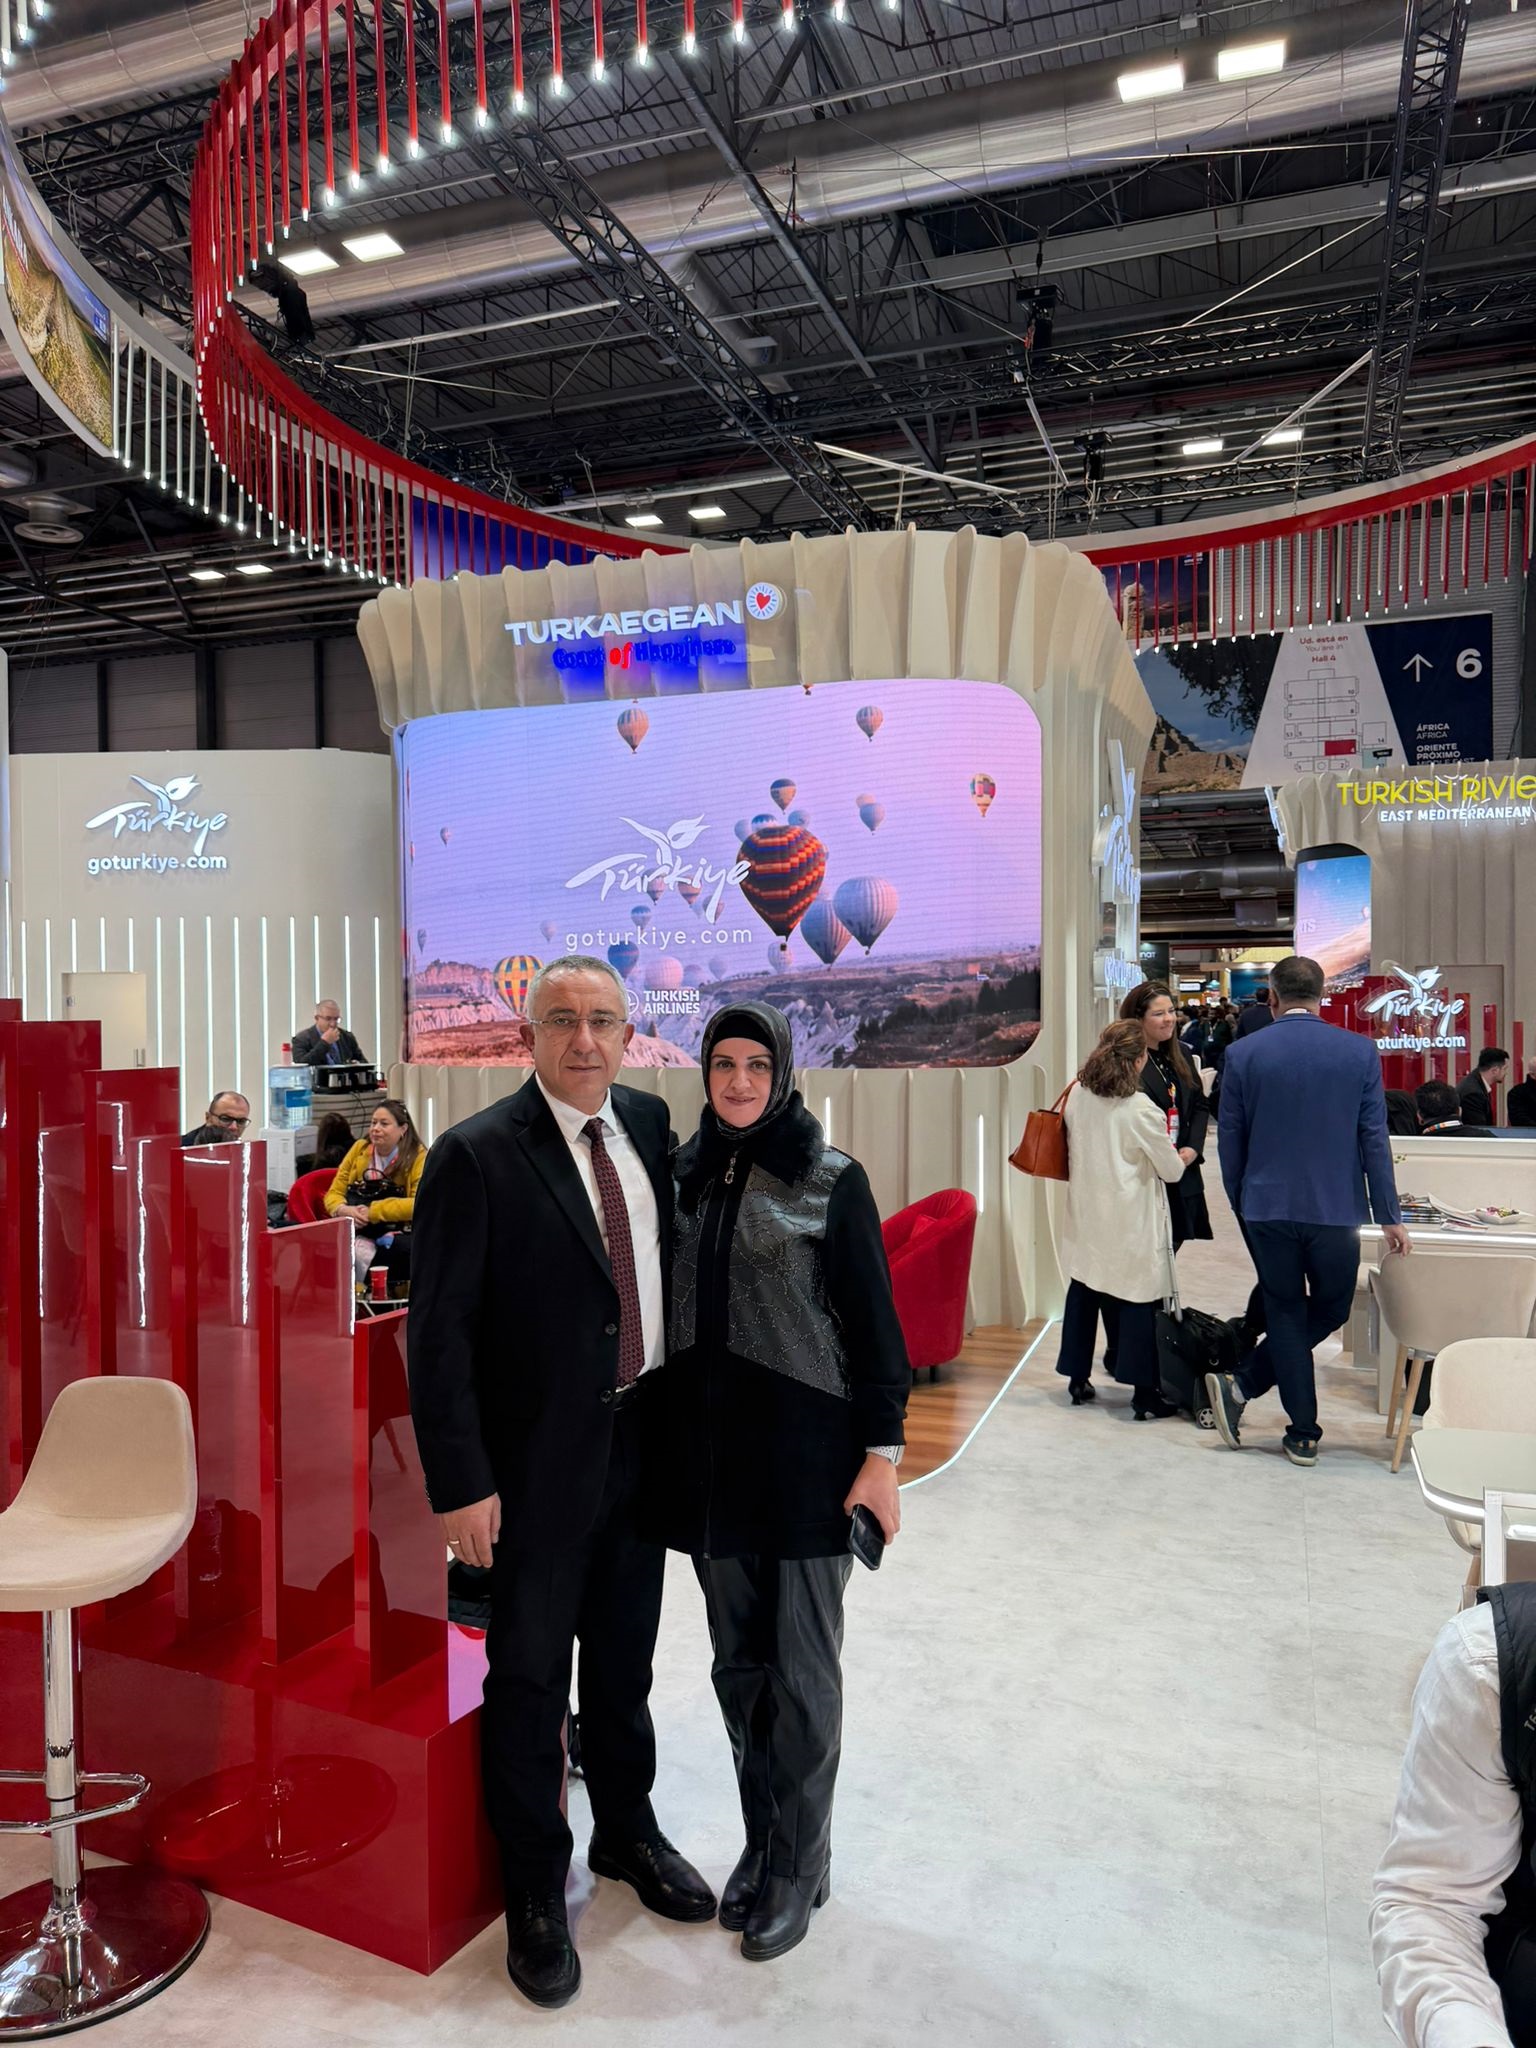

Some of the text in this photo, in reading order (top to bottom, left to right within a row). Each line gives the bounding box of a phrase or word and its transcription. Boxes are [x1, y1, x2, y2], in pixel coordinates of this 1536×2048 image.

[504, 599, 744, 645] TURKAEGEAN
[609, 641, 632, 669] of
[1456, 648, 1483, 679] 6
[1416, 722, 1451, 732] ÁFRICA
[1416, 743, 1458, 752] ORIENTE
[1337, 780, 1453, 807] TURKISH
[85, 796, 228, 857] Türkiye
[1380, 805, 1531, 823] EAST MEDITERRANEAN
[87, 853, 228, 875] goturkiye.com
[564, 851, 752, 924] Türkiye
[565, 925, 752, 952] goturkiye.com
[643, 990, 700, 1003] TURKISH
[643, 1002, 700, 1015] AIRLINES
[1366, 988, 1465, 1038] Türkiye
[1376, 1033, 1466, 1052] oturkiye.com
